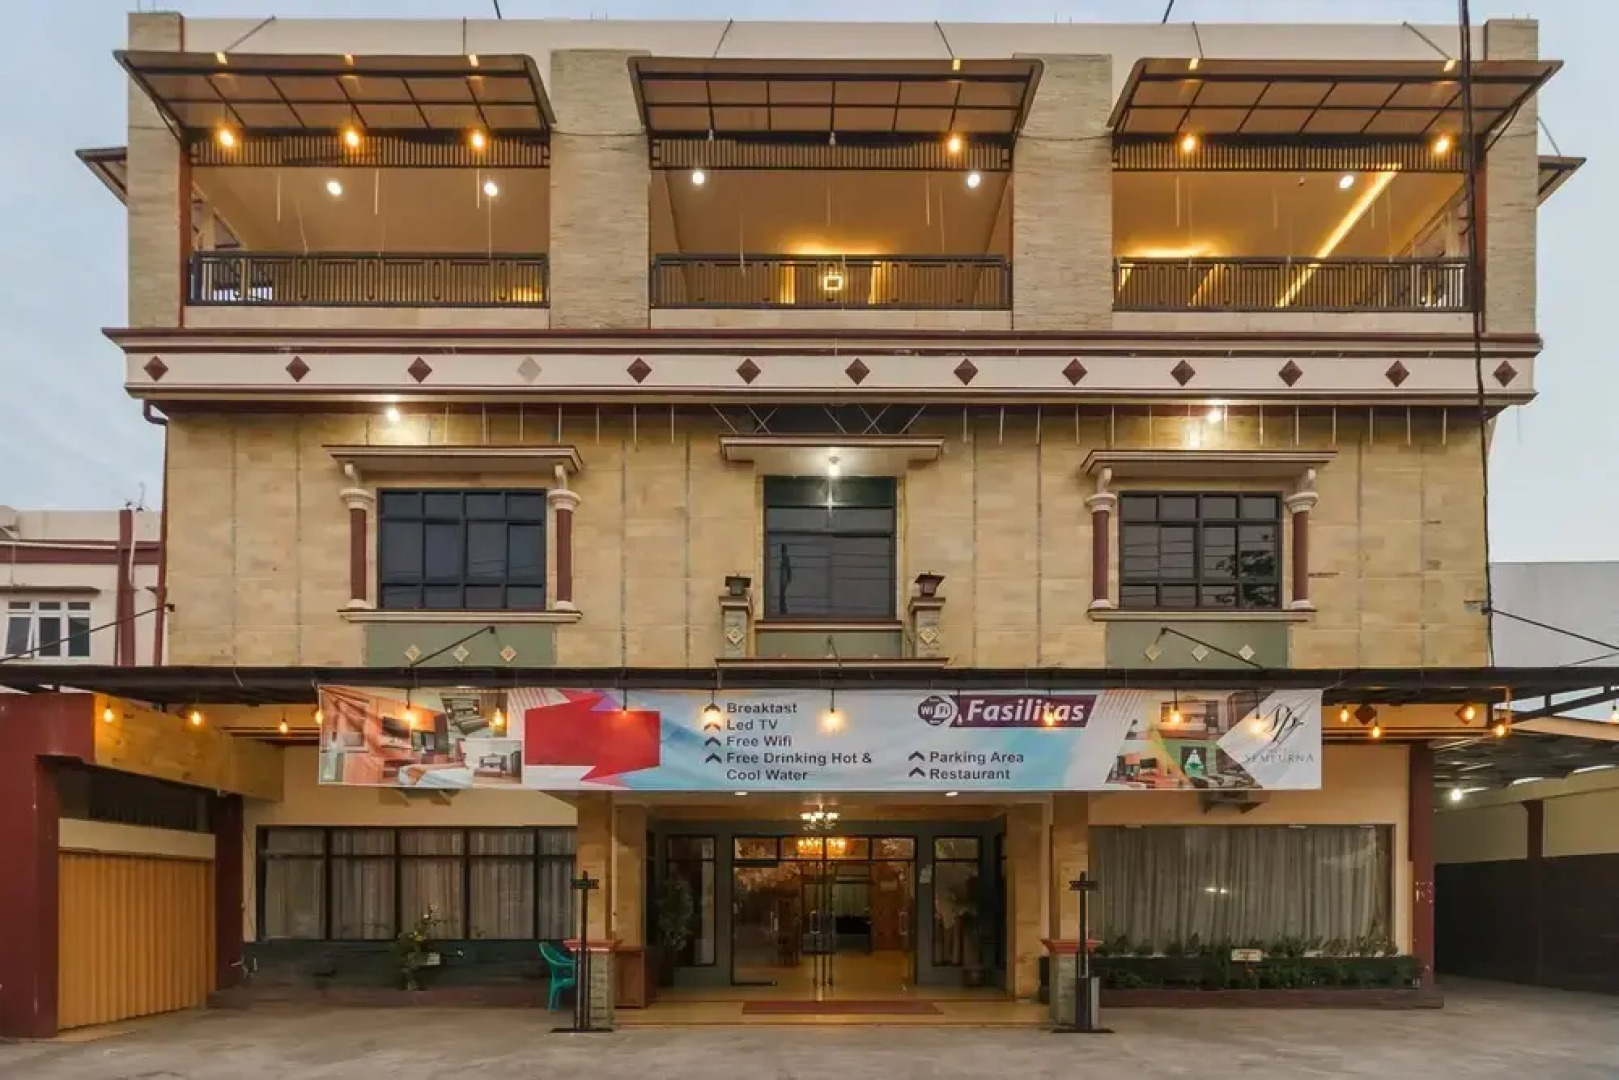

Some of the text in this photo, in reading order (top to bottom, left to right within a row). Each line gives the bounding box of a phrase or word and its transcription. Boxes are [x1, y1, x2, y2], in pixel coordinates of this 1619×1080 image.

[967, 699, 1084, 721] Fasilitas
[726, 719, 778, 731] Led TV
[726, 735, 792, 747] Free Wifi
[726, 752, 872, 766] Free Drinking Hot &
[930, 751, 1024, 766] Parking Area
[726, 769, 808, 781] Cool Water
[930, 768, 1010, 780] Restaurant
